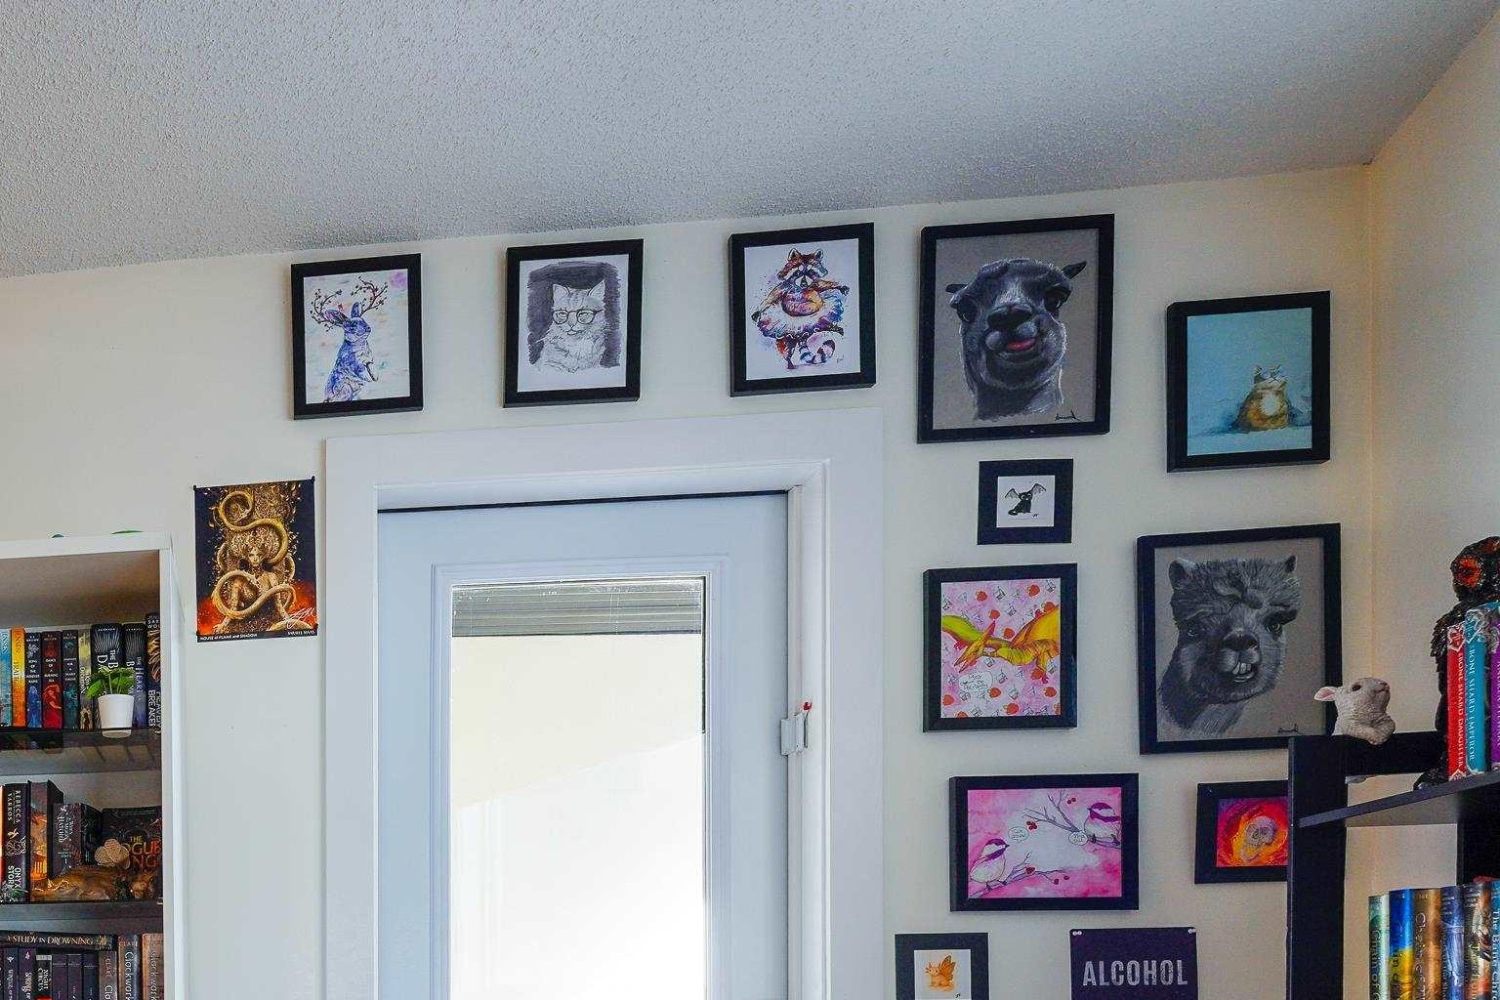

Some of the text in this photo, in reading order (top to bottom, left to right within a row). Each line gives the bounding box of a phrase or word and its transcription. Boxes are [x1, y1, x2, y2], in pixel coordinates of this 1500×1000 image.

[12, 935, 94, 945] STUDY DROWNING
[1082, 959, 1188, 986] ALCOHOL
